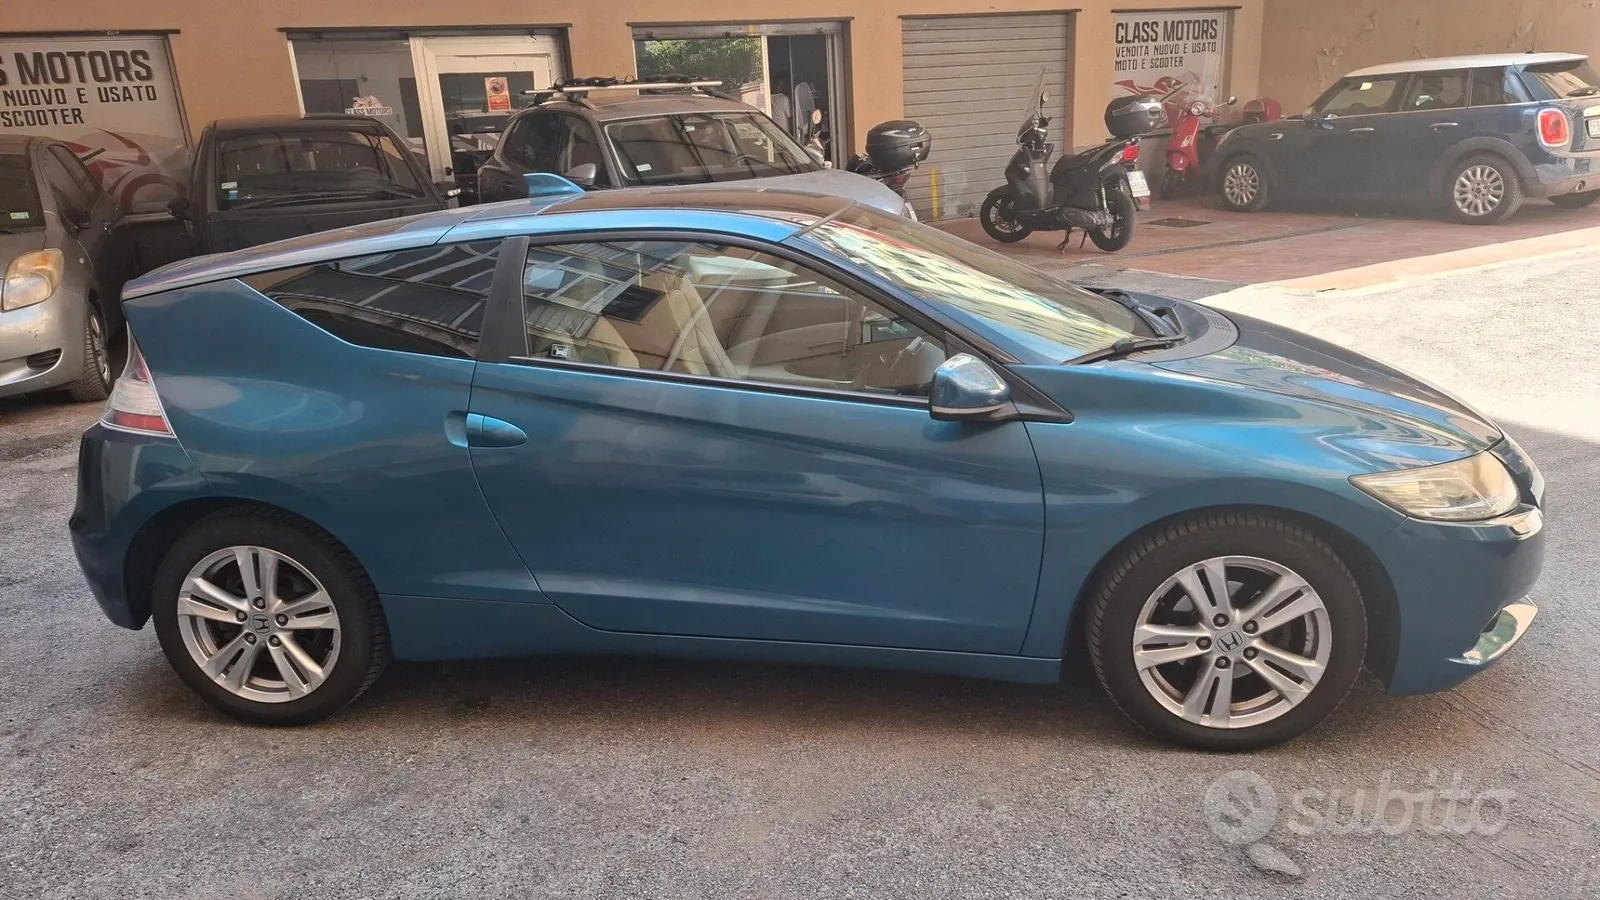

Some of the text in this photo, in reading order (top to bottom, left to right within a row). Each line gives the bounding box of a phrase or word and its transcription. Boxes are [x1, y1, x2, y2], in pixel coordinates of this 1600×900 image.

[1115, 19, 1218, 44] CLASS MOTORS
[1115, 41, 1217, 58] VENDITA NUOVO E USATO
[13, 49, 153, 85] MOTORS
[1114, 56, 1184, 71] MOTO E SCOOTER
[2, 85, 157, 107] NUOVO E USATO
[0, 107, 85, 128] SCOOTER
[366, 107, 392, 115] MOTORS
